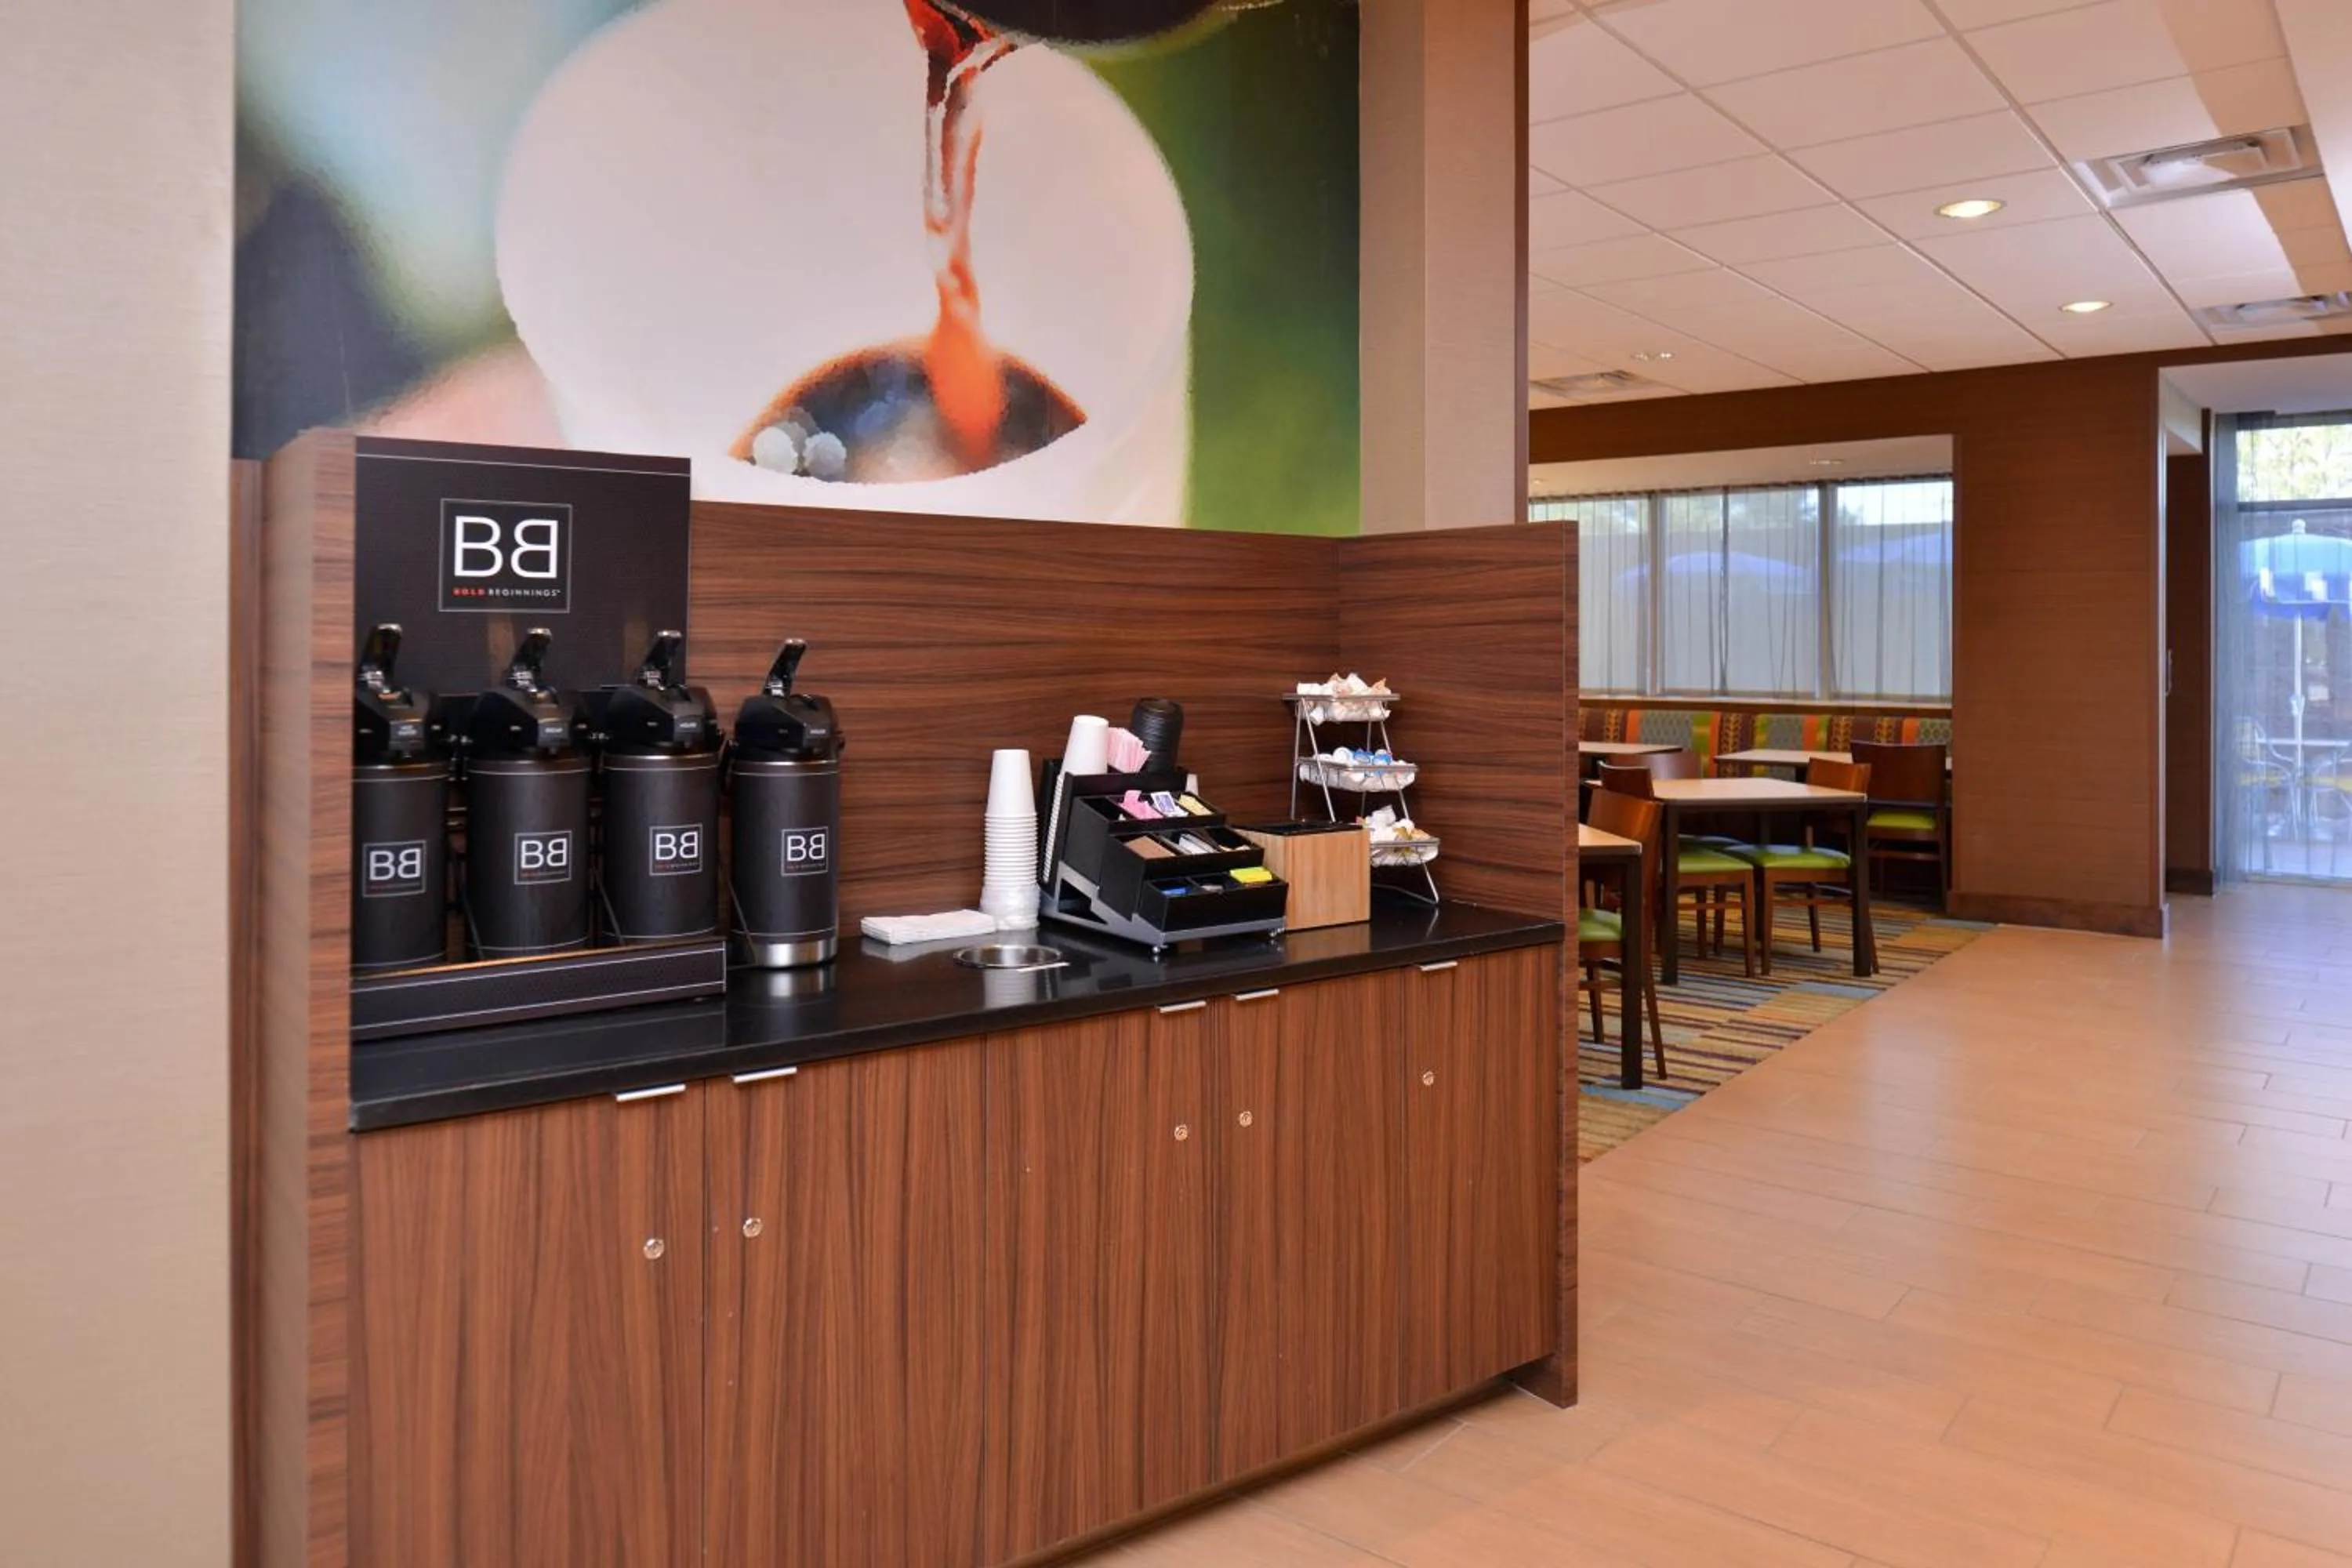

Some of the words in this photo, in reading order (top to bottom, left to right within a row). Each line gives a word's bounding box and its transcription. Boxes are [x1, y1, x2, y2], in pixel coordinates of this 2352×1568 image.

[454, 515, 558, 579] BB
[521, 838, 567, 869] BB
[655, 832, 698, 860] BB
[787, 833, 825, 861] BB
[369, 848, 421, 880] BB
